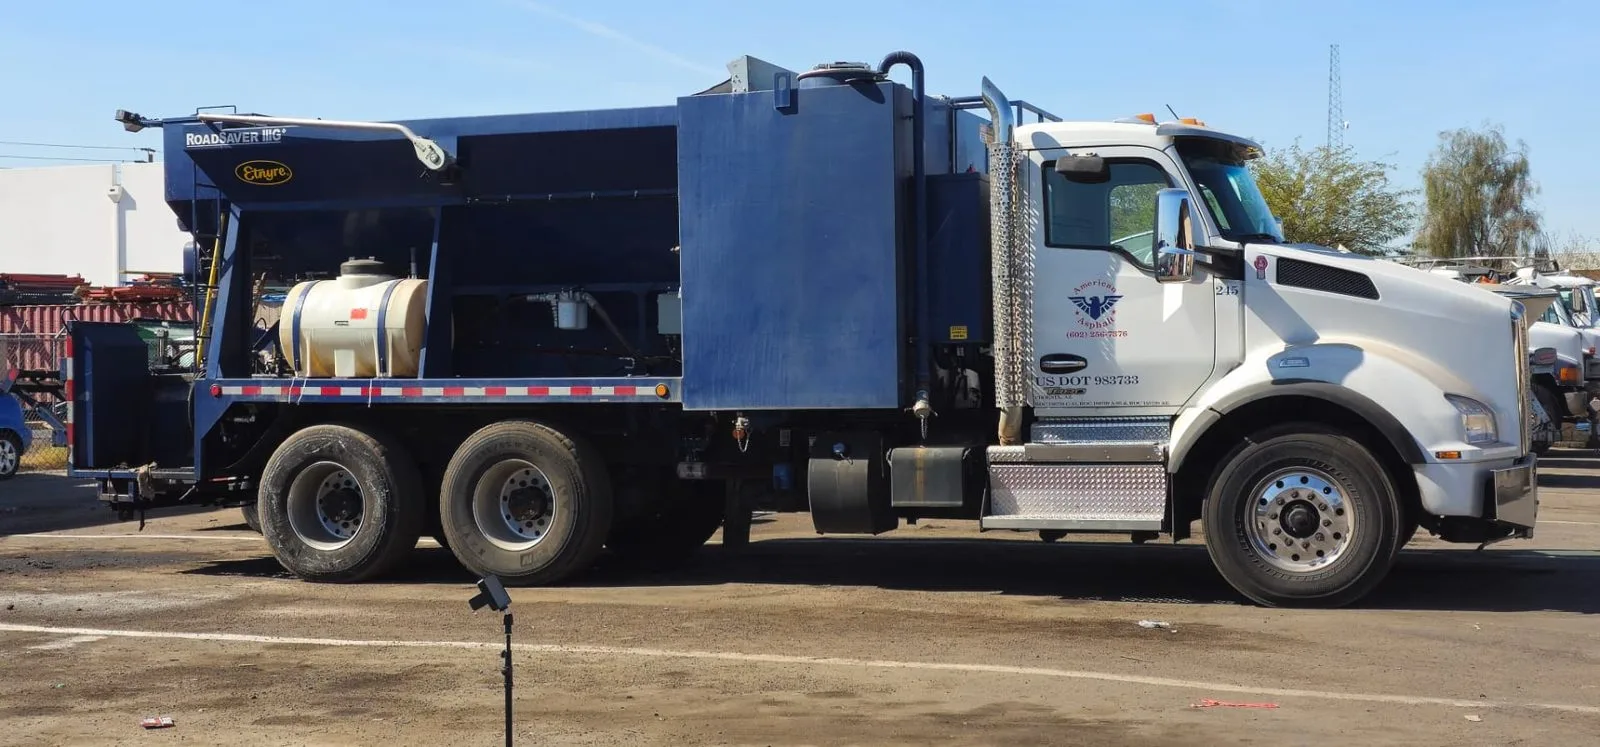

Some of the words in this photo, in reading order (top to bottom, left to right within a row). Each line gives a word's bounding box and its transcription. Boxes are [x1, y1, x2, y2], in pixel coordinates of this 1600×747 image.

[243, 165, 286, 181] Etnyre
[1073, 279, 1117, 296] American
[1077, 316, 1115, 330] Asphalt
[1066, 331, 1088, 339] (602)
[1035, 376, 1056, 387] US
[1059, 375, 1091, 386] DOT
[1094, 375, 1139, 385] 983733
